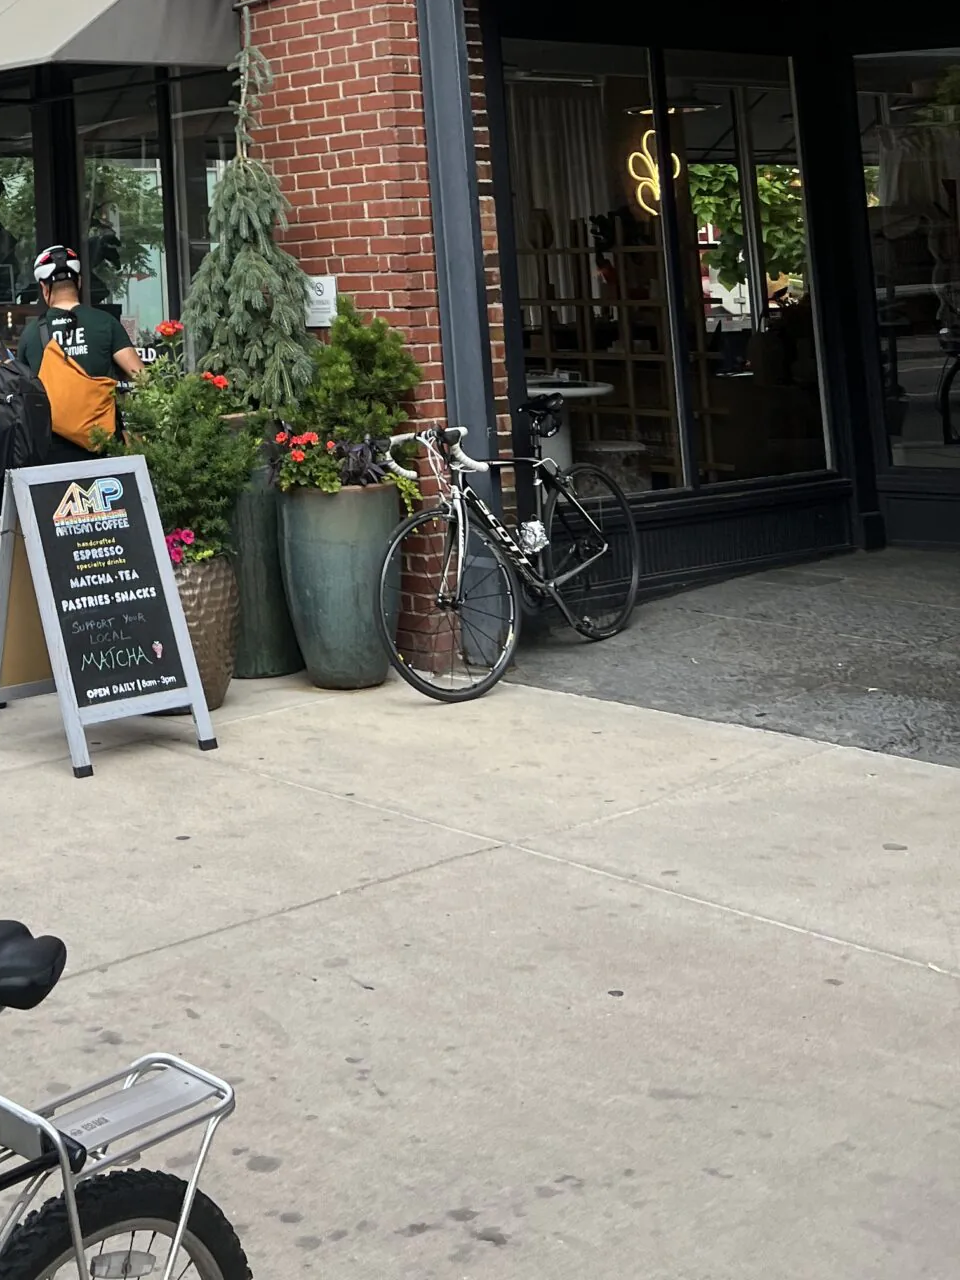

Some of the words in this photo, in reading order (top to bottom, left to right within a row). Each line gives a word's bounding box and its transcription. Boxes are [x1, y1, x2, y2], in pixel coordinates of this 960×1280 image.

[53, 477, 124, 520] AMP
[94, 517, 130, 532] COFFEE
[76, 537, 116, 548] handcrafted
[73, 545, 124, 562] ESPRESSO
[89, 629, 133, 645] LOCAL
[81, 645, 154, 672] MATCHA
[86, 686, 111, 699] OPEN
[112, 681, 136, 694] DAILY
